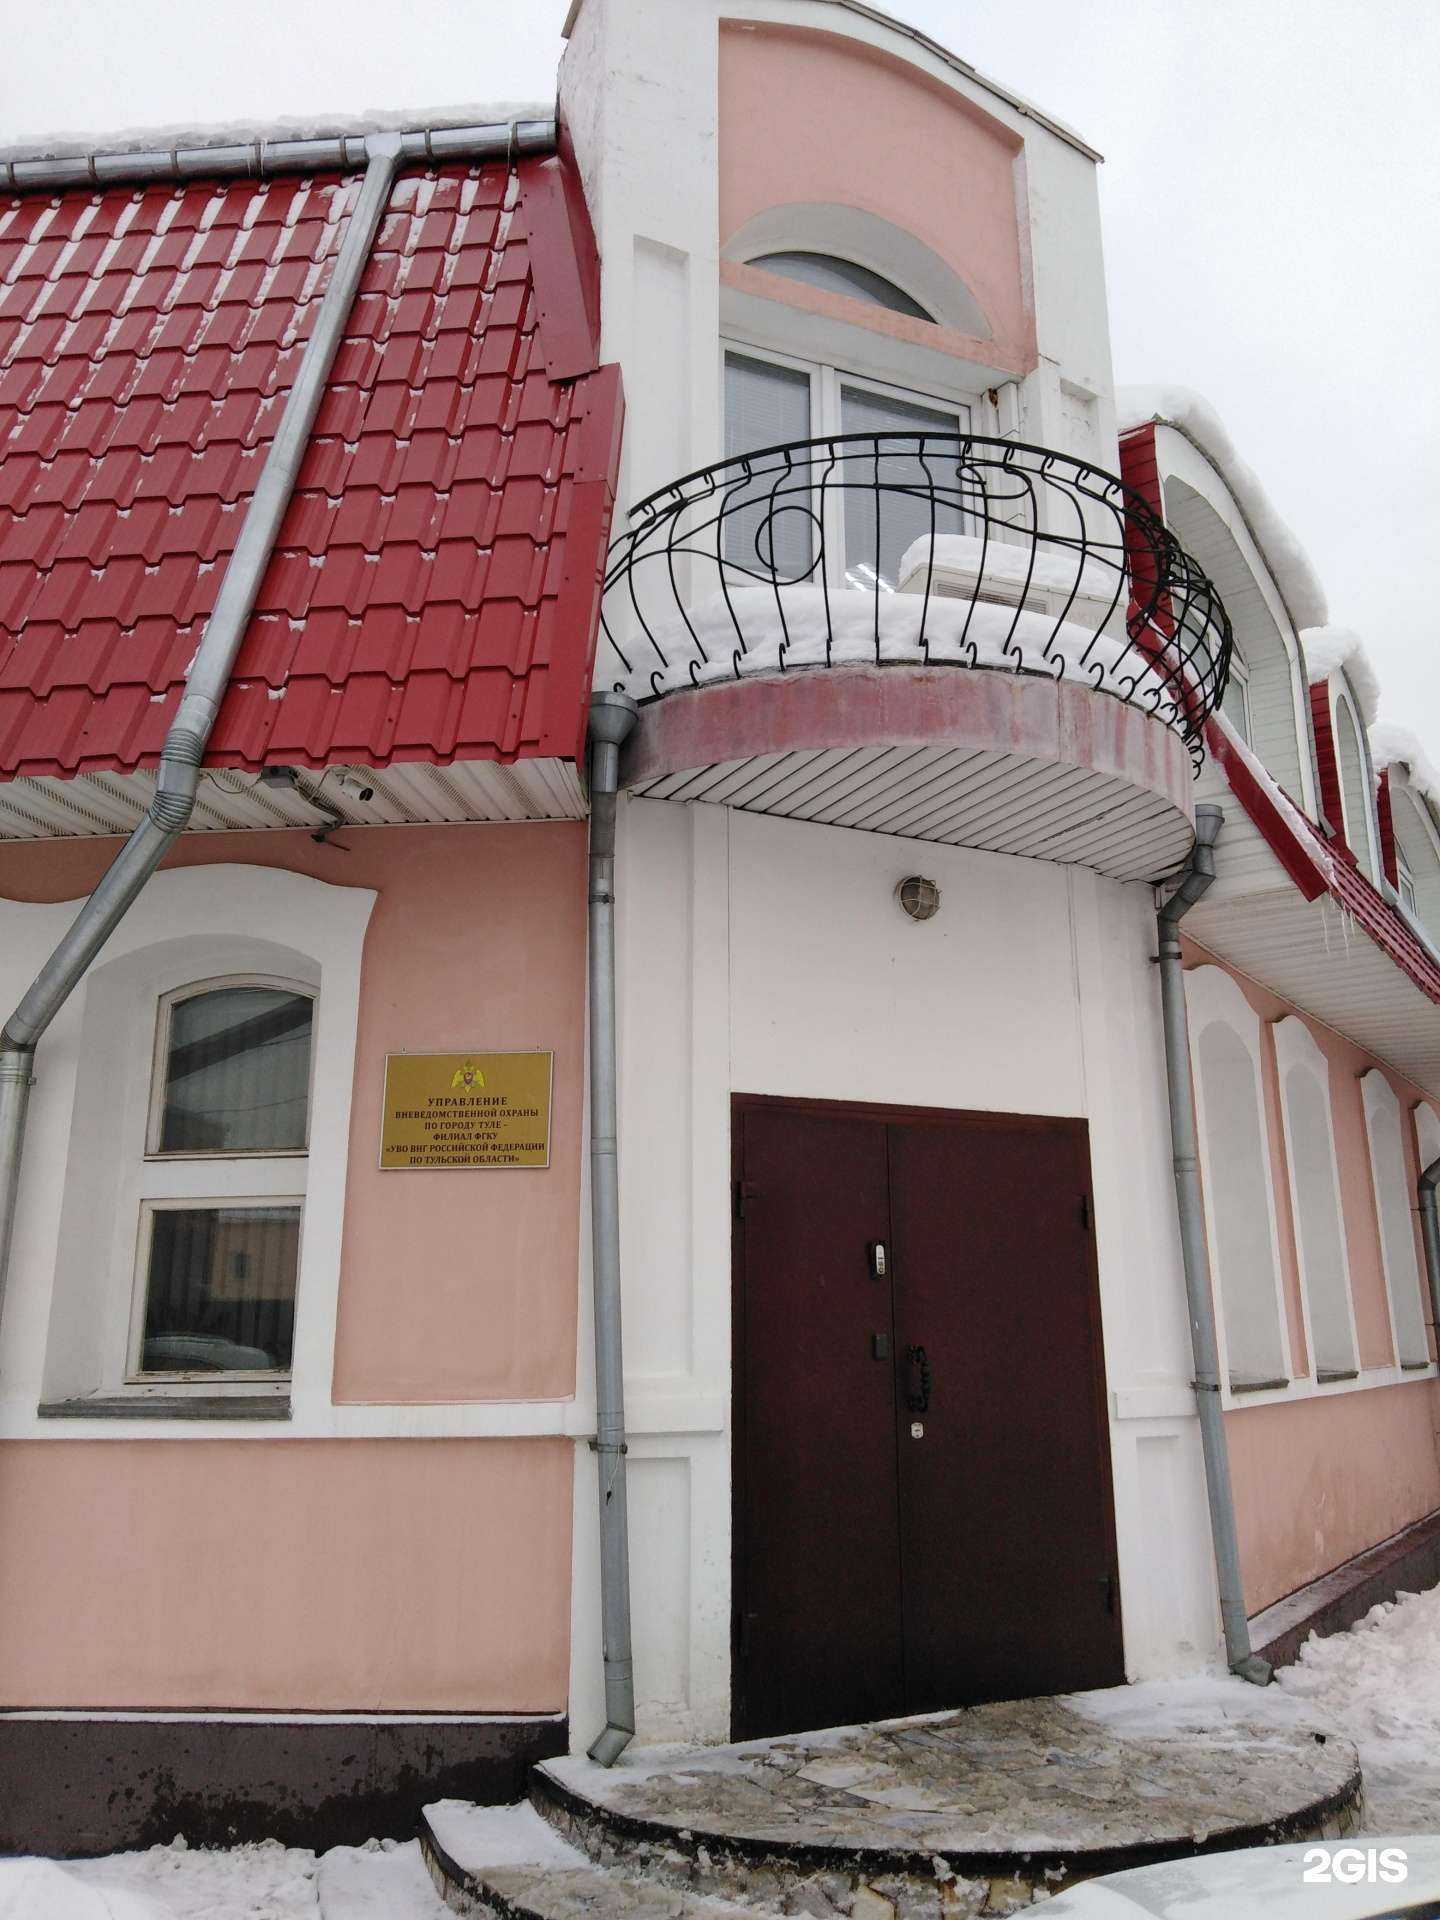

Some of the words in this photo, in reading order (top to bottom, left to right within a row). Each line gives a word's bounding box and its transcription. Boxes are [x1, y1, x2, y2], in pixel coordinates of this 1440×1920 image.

[428, 1097, 508, 1106] УПРАВЛЕНИЕ
[396, 1110, 497, 1119] ВНЕВЕДОМСТВЕННОЙ
[500, 1109, 538, 1117] ОХРАНЫ
[425, 1122, 437, 1130] ПО
[440, 1122, 475, 1130] ГОРОДУ
[430, 1143, 488, 1152] РОССИЙСКОЙ
[490, 1143, 544, 1152] ФЕДЕРАЦИИ
[410, 1156, 422, 1164] ПО
[424, 1155, 470, 1163] ТУЛЬСКОЙ
